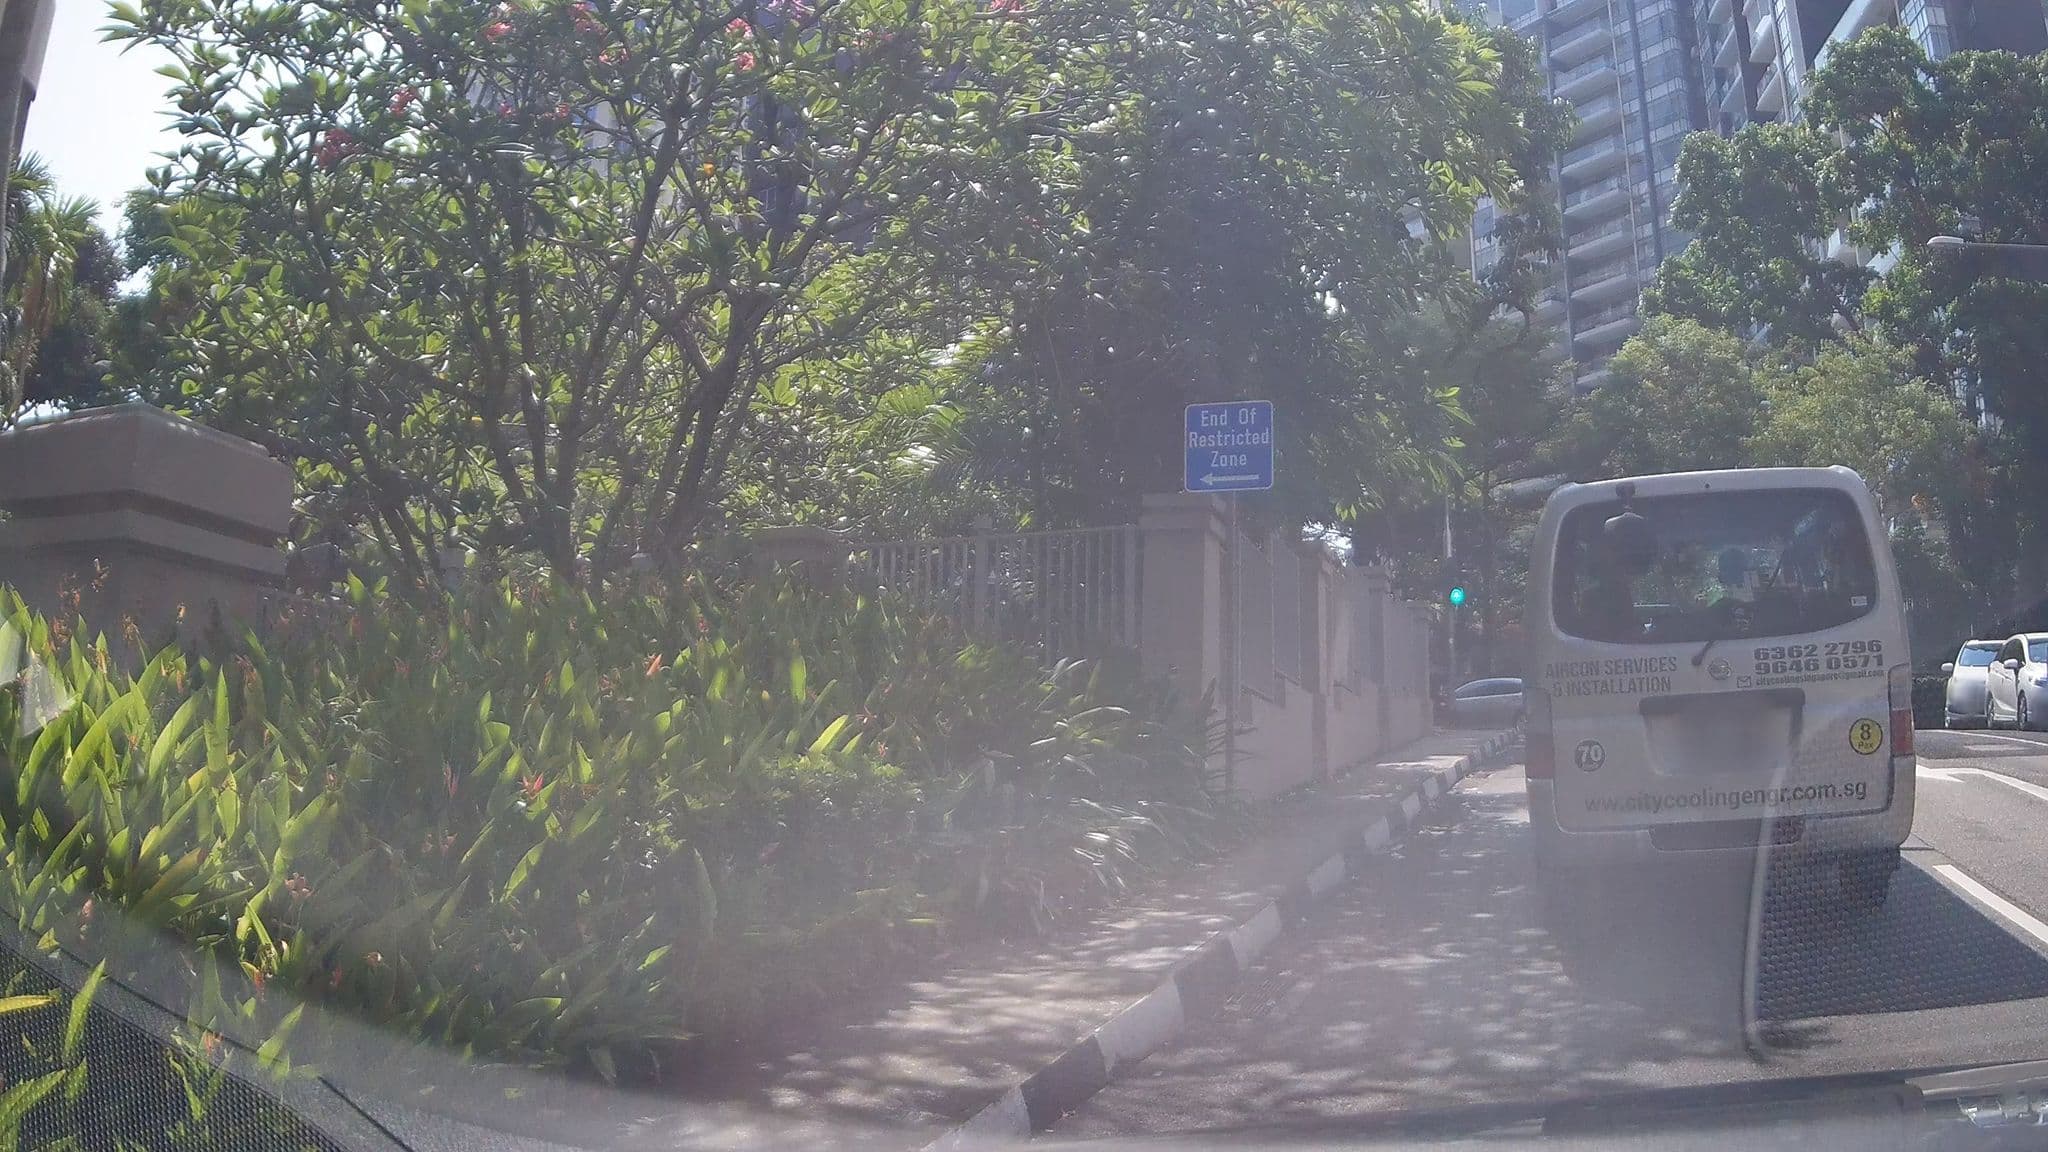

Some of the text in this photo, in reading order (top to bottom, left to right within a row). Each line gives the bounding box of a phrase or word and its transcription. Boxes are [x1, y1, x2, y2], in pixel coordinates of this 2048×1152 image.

[1201, 407, 1257, 427] End Of
[1189, 427, 1270, 448] Restricted
[1210, 450, 1248, 468] Zone
[1753, 639, 1883, 661] 6362 2796
[1545, 656, 1678, 679] AIRCON SERVICES
[1754, 654, 1884, 675] 9646 0571
[1566, 676, 1672, 697] INSTALLATION
[1860, 723, 1871, 741] 8
[1577, 743, 1602, 764] 70
[1584, 780, 1868, 813] www.citycoolingengr.com.sg
